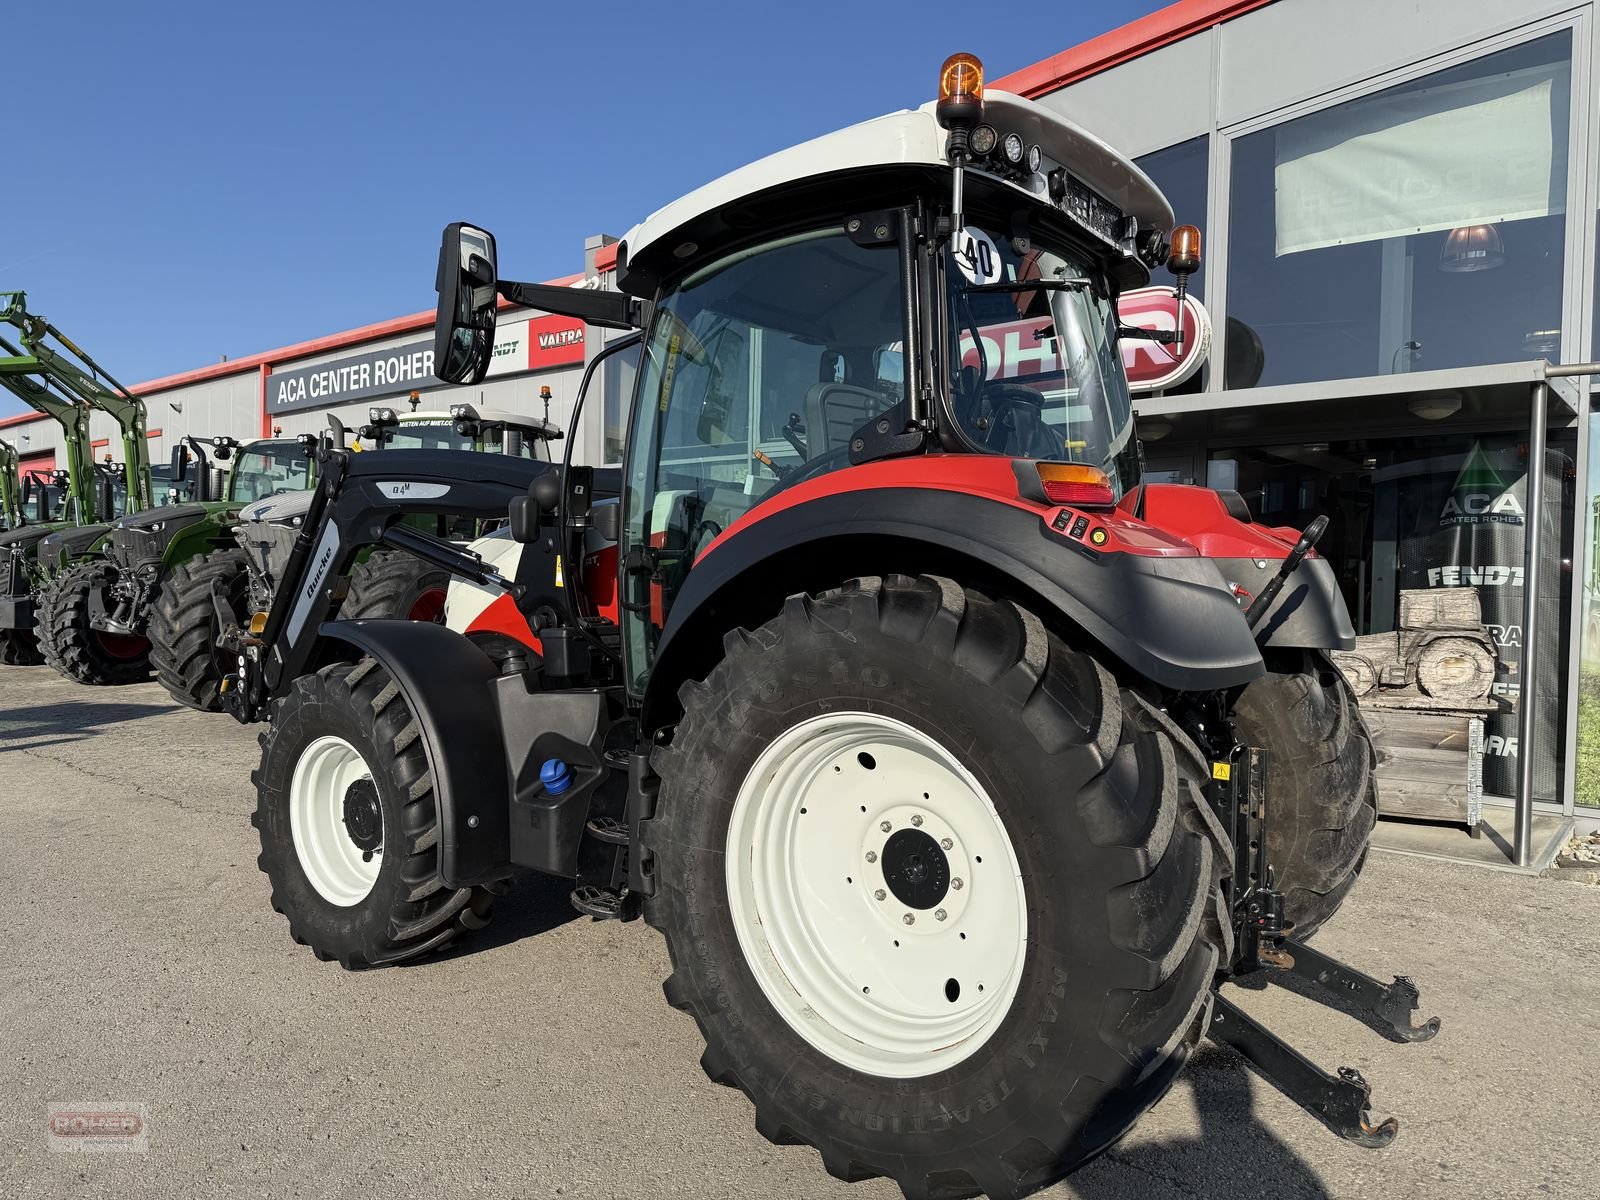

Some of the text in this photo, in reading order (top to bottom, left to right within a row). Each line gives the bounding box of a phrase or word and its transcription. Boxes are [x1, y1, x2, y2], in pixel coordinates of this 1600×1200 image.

[965, 237, 993, 278] 40
[492, 340, 519, 357] NDT
[538, 327, 584, 350] VALTRA
[277, 349, 435, 404] ACA CENTER ROHER
[1440, 493, 1525, 518] ACA
[1440, 515, 1525, 527] CENTER ROHER
[307, 547, 333, 600] Quicke
